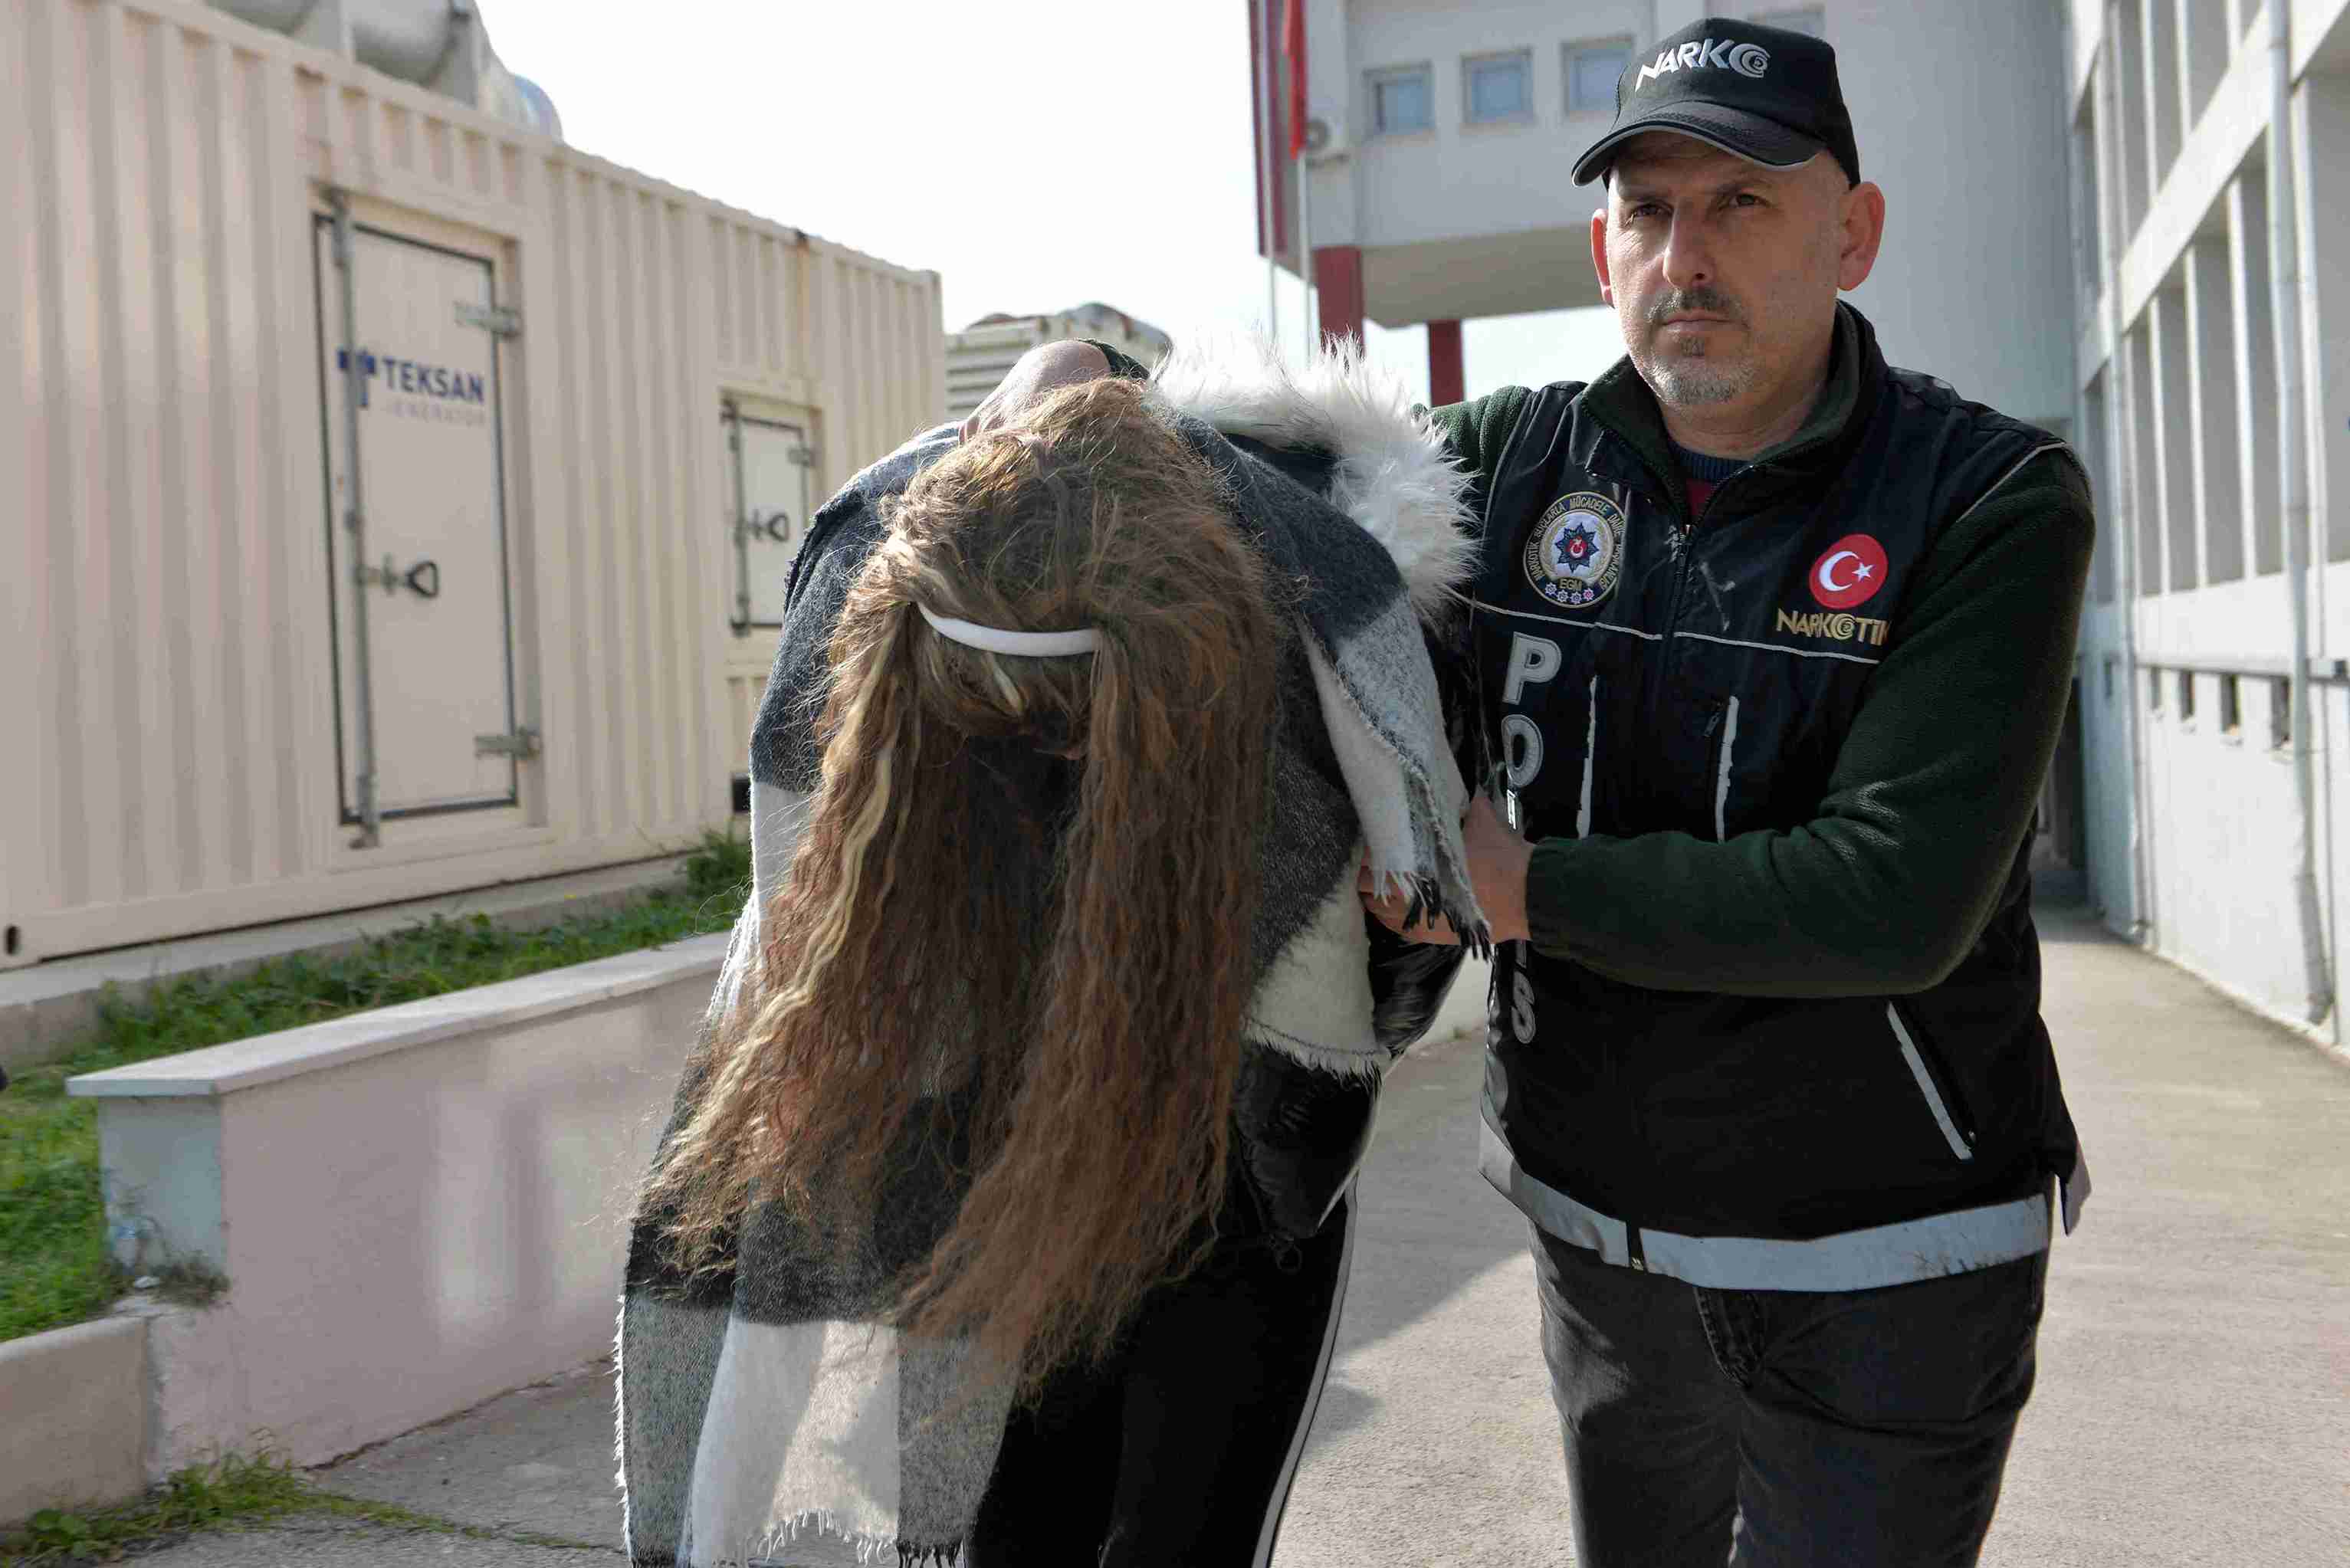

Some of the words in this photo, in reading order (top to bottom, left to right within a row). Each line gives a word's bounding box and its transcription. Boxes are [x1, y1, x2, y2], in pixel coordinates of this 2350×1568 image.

[1635, 38, 1771, 93] NARKO
[382, 357, 485, 404] TEKSAN
[1560, 578, 1583, 590] EGM
